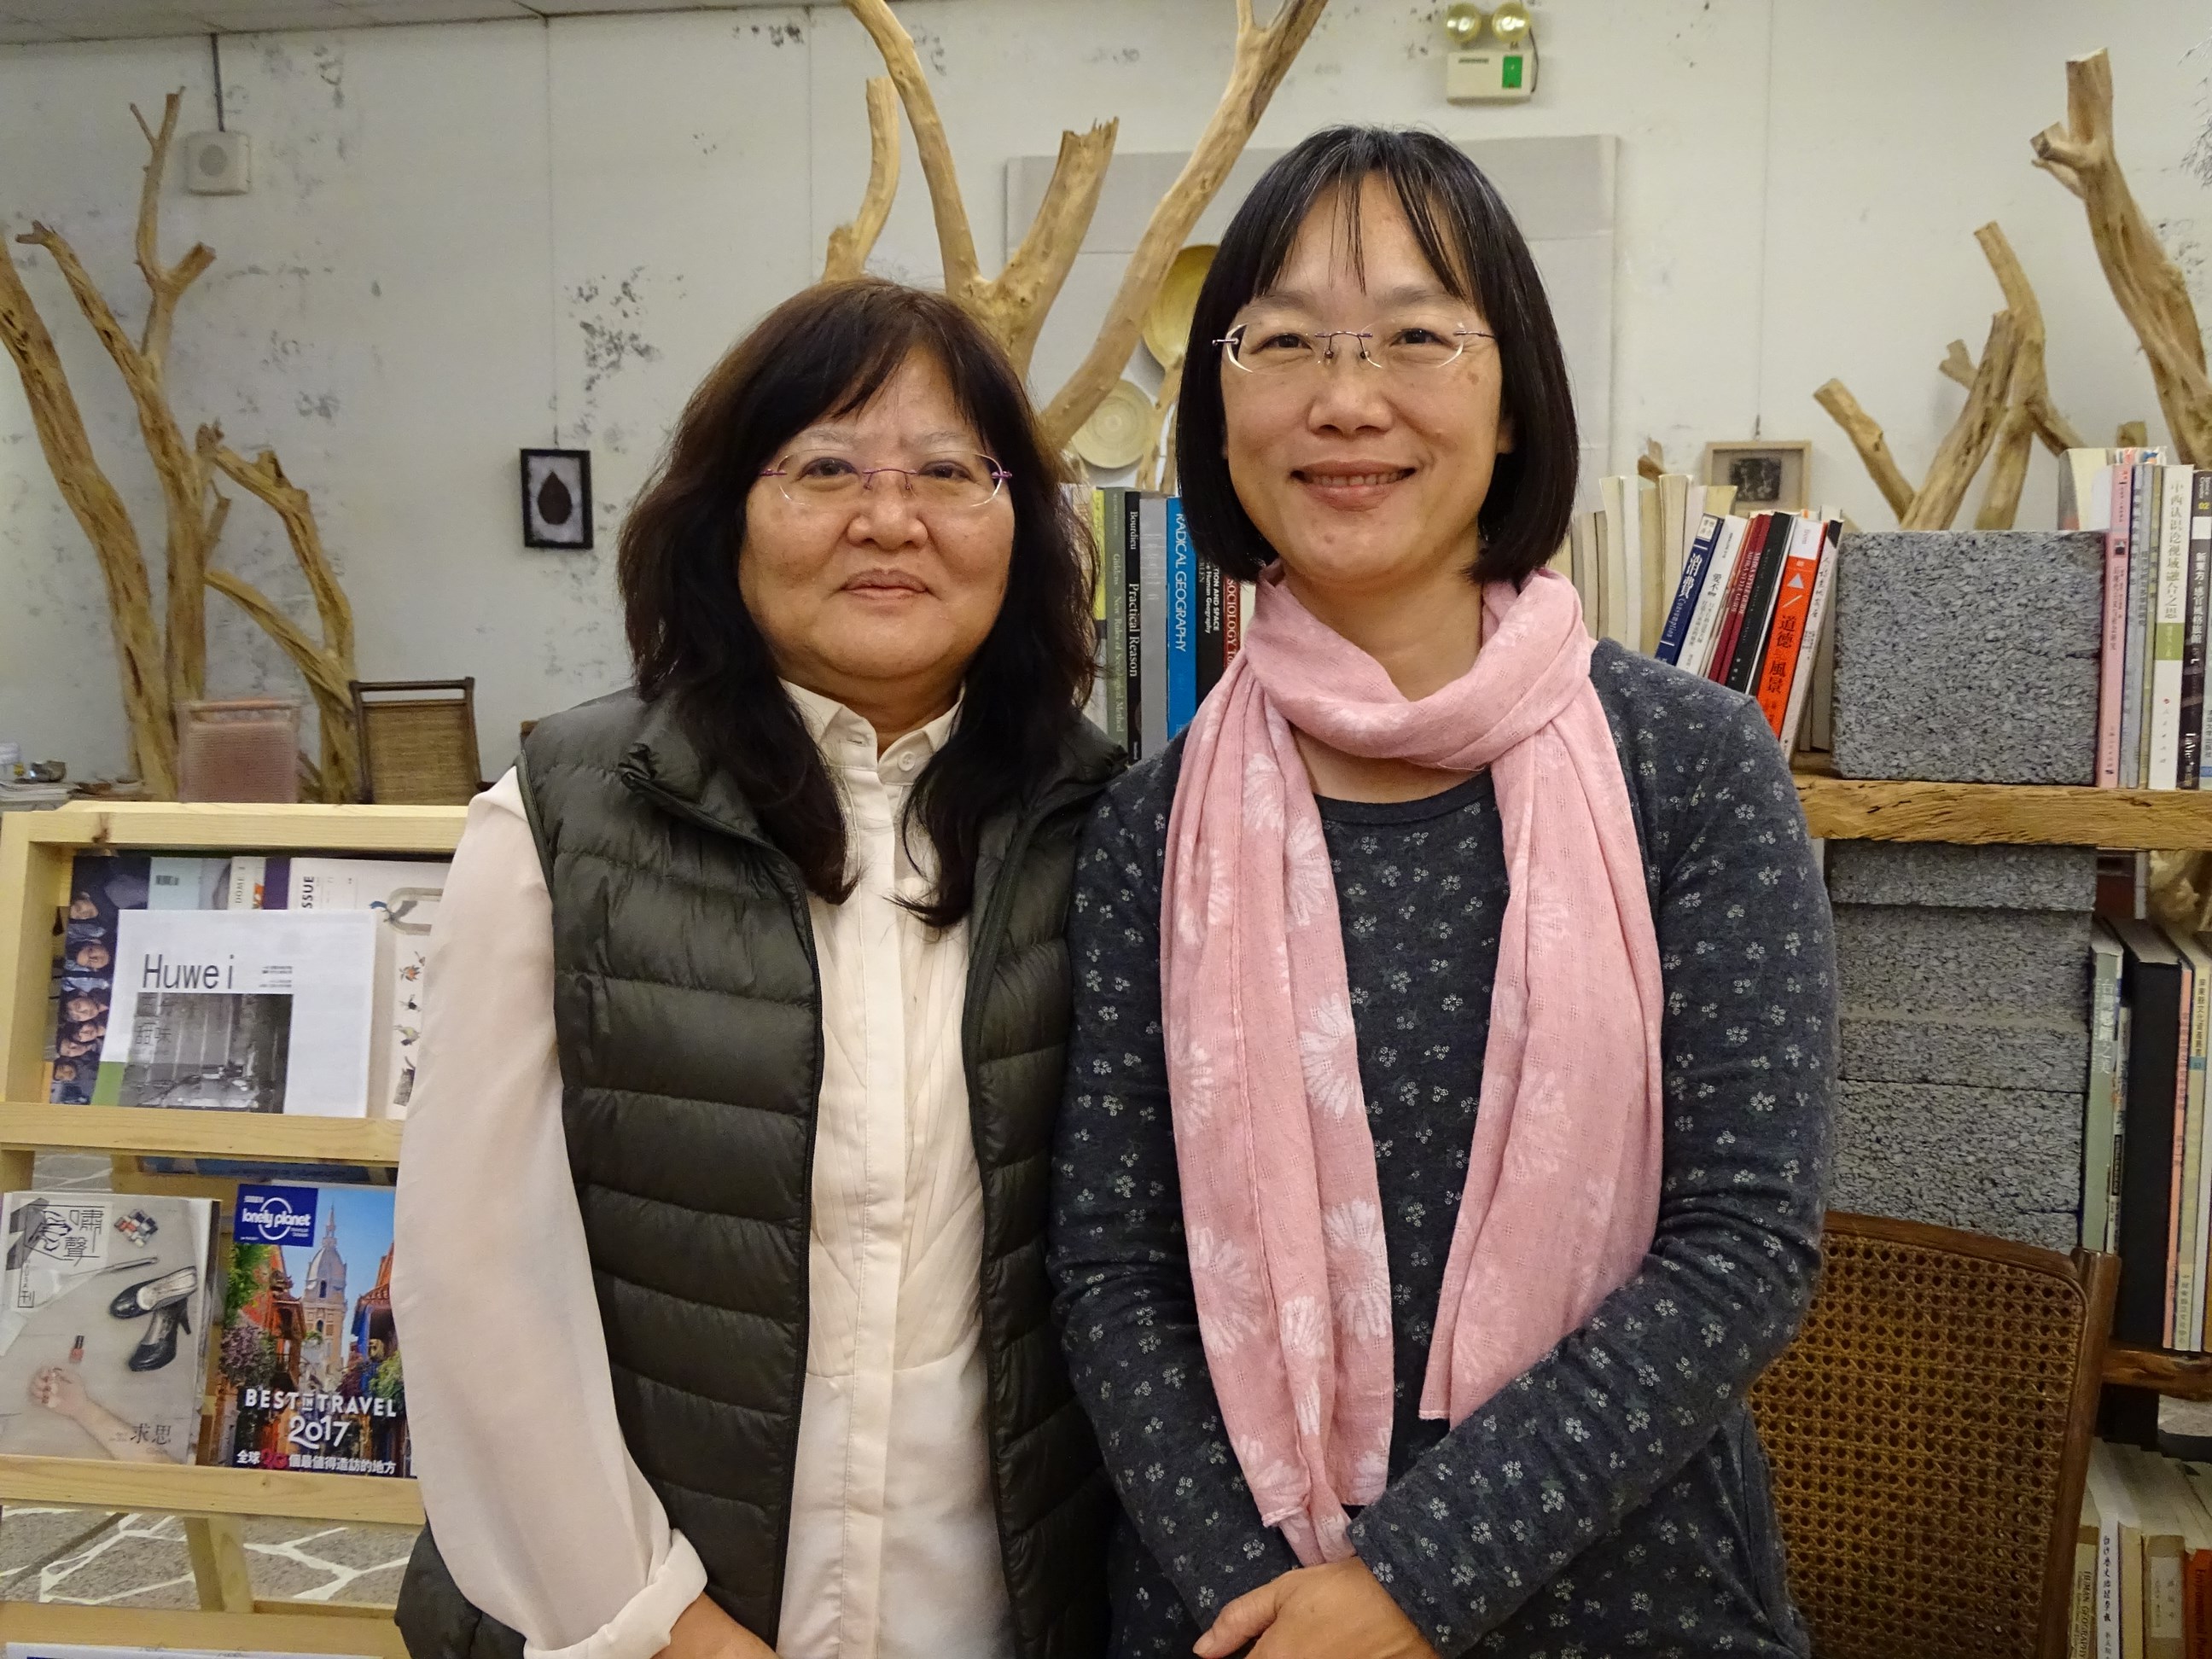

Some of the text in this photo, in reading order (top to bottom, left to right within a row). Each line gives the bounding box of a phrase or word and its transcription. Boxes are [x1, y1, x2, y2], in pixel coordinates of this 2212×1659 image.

[1130, 511, 1139, 550] Bourdieu
[1175, 513, 1186, 652] RADICAL GEOGRAPHY
[1114, 595, 1122, 614] New
[1226, 579, 1237, 646] SOCIOLOGY
[1737, 594, 1749, 616] GUIDE
[1114, 618, 1122, 640] Rules
[1128, 583, 1140, 678] Practical Reason
[1115, 642, 1123, 650] of
[1115, 701, 1124, 732] Method
[301, 876, 315, 909] SSUE
[143, 954, 236, 989] Huwei
[242, 1208, 311, 1228] lonely planet
[244, 1388, 397, 1417] BEST IN TRAVEL
[288, 1415, 352, 1450] 2017
[2079, 1570, 2093, 1659] HUMAN GEOGRAPHY
